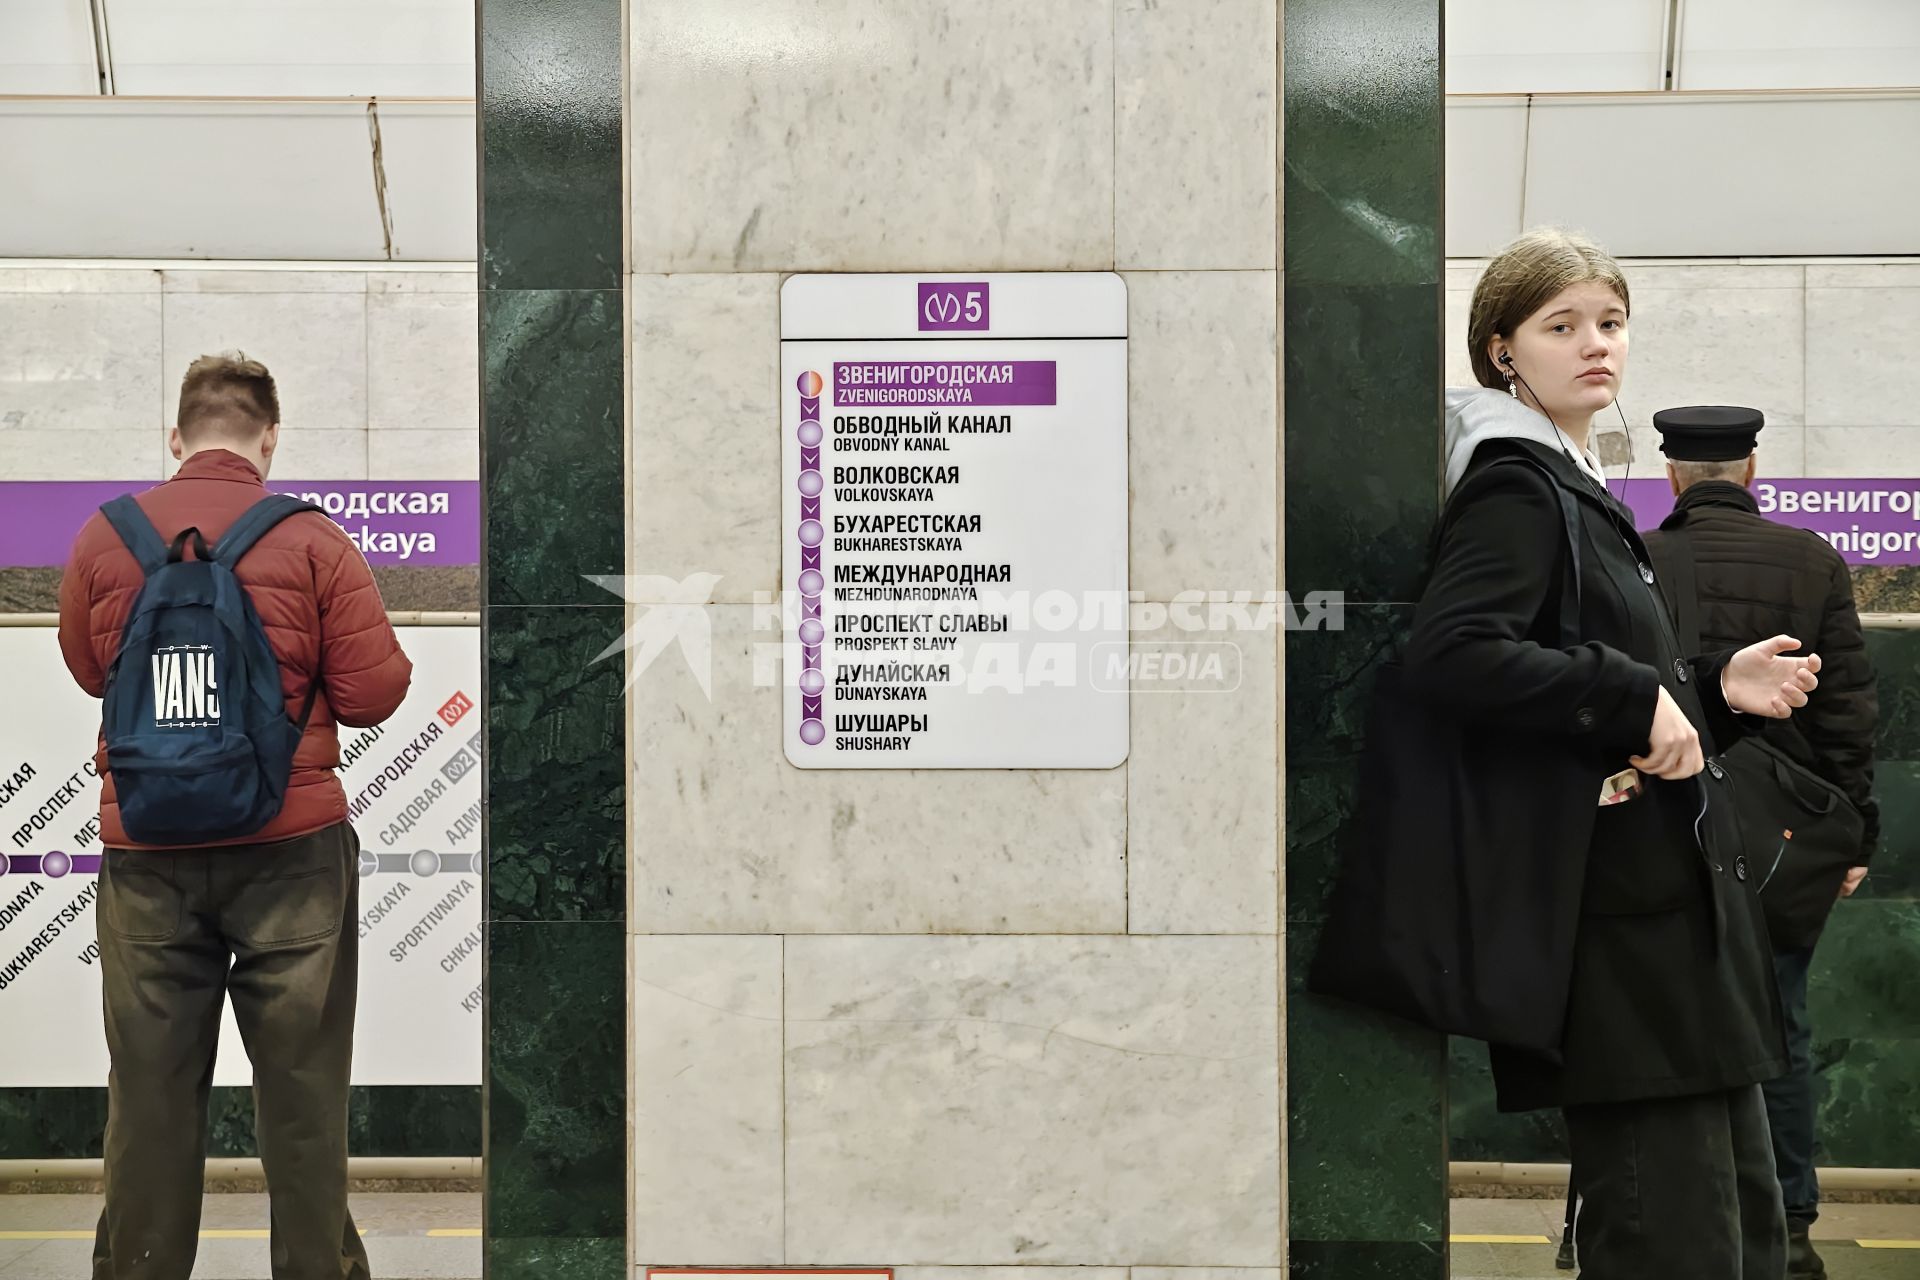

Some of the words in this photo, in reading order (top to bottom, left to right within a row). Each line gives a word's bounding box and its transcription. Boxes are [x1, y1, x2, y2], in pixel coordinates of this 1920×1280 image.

[965, 291, 982, 323] 5
[838, 364, 1014, 385] ЗВЕНИГОРОДСКАЯ
[838, 388, 973, 403] ZVENIGORODSKAYA
[833, 412, 942, 437] ОБВОДНЫЙ
[948, 416, 1012, 434] КАНАЛ
[833, 438, 900, 452] OBVODNY
[904, 438, 950, 452] KANAL
[833, 466, 960, 485] ВОЛКОВСКАЯ
[834, 488, 934, 502] VOLKOVSKAYA
[833, 515, 982, 533] БУХАРЕСТСКАЯ
[341, 525, 436, 559] skaya
[834, 537, 962, 551] BUKHARESTSKAYA
[834, 565, 1012, 585] МЕЖДУНАРОДНАЯ
[834, 587, 978, 601] MEZHDUNARODNAYA
[834, 615, 933, 633] ПРОСПЕКТ
[939, 615, 1008, 633] СЛАВЫ
[834, 637, 909, 651] PROSPEKT
[913, 637, 957, 651] SLAVY
[836, 660, 950, 685] ДУНАЙСКАЯ
[835, 687, 927, 701] DUNAYSKAYA
[835, 715, 928, 733] ШУШАРЫ
[835, 737, 911, 751] SHUSHARY
[0, 762, 37, 808] СКАЯ
[12, 772, 85, 848] ПРОСПЕКТ
[379, 778, 447, 846] САДОВАЯ
[389, 879, 474, 962] SPORTIVNAYA
